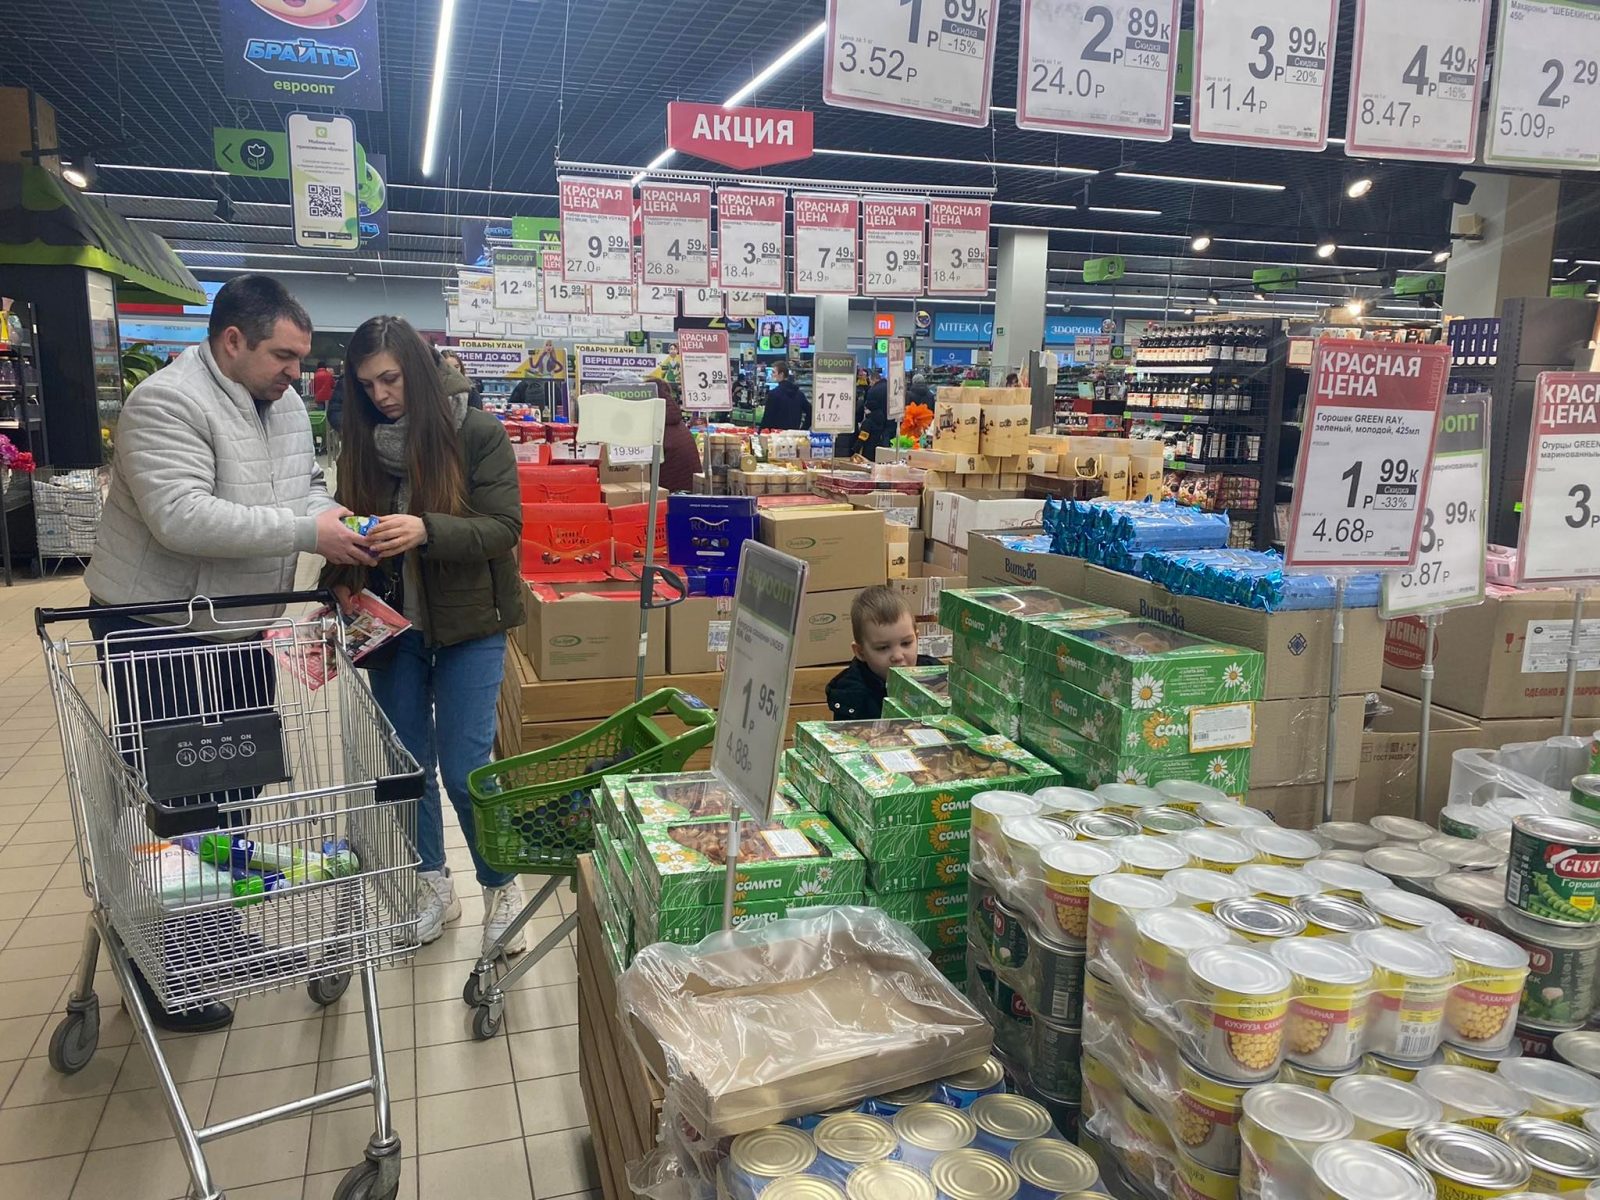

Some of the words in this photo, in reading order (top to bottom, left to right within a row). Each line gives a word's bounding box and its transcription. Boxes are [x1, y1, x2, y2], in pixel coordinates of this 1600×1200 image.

[948, 38, 977, 55] -15%
[248, 39, 357, 68] БРАЙТЫ
[1132, 53, 1160, 68] -14%
[1292, 70, 1318, 83] -20%
[273, 80, 335, 95] евроопт
[692, 113, 794, 149] АКЦИЯ
[563, 185, 623, 200] КРАСНАЯ
[642, 190, 701, 203] КРАСНАЯ
[563, 196, 600, 209] ЦЕНА
[720, 194, 775, 206] КРАСНАЯ
[643, 201, 678, 213] ЦЕНА
[720, 205, 753, 216] ЦЕНА
[796, 201, 849, 213] КРАСНАЯ
[865, 204, 917, 216] КРАСНАЯ
[932, 204, 982, 216] КРАСНАЯ
[796, 211, 829, 224] ЦЕНА
[865, 215, 896, 227] ЦЕНА
[932, 214, 962, 225] ЦЕНА
[544, 260, 561, 269] ЦЕН
[937, 322, 979, 332] АПТЕКА
[680, 334, 718, 342] КРАСНАЯ
[681, 342, 704, 350] ЦЕНА
[484, 353, 500, 361] ДО
[500, 353, 519, 361] 40%
[584, 356, 621, 365] ВЕРНЕМ
[622, 358, 635, 366] ДО
[636, 358, 654, 367] 40%
[1321, 351, 1422, 377] КРАСНАЯ
[1318, 373, 1378, 399] ЦЕНА
[1542, 384, 1600, 404] КРАС
[1317, 412, 1353, 423] Горошек
[1354, 414, 1384, 424] GREEN
[1385, 416, 1405, 425] RAY,
[1540, 404, 1597, 428] ЦЕНА
[1315, 424, 1354, 433] зеленый,
[1355, 426, 1394, 435] молодой,
[1395, 427, 1420, 435] 425мл
[1541, 441, 1572, 450] Огурцы
[1381, 497, 1408, 508] -33%
[1155, 723, 1189, 737] сал
[1560, 858, 1600, 874] GUST
[736, 879, 782, 891] салита
[1224, 1019, 1261, 1031] КУКУРУЗА
